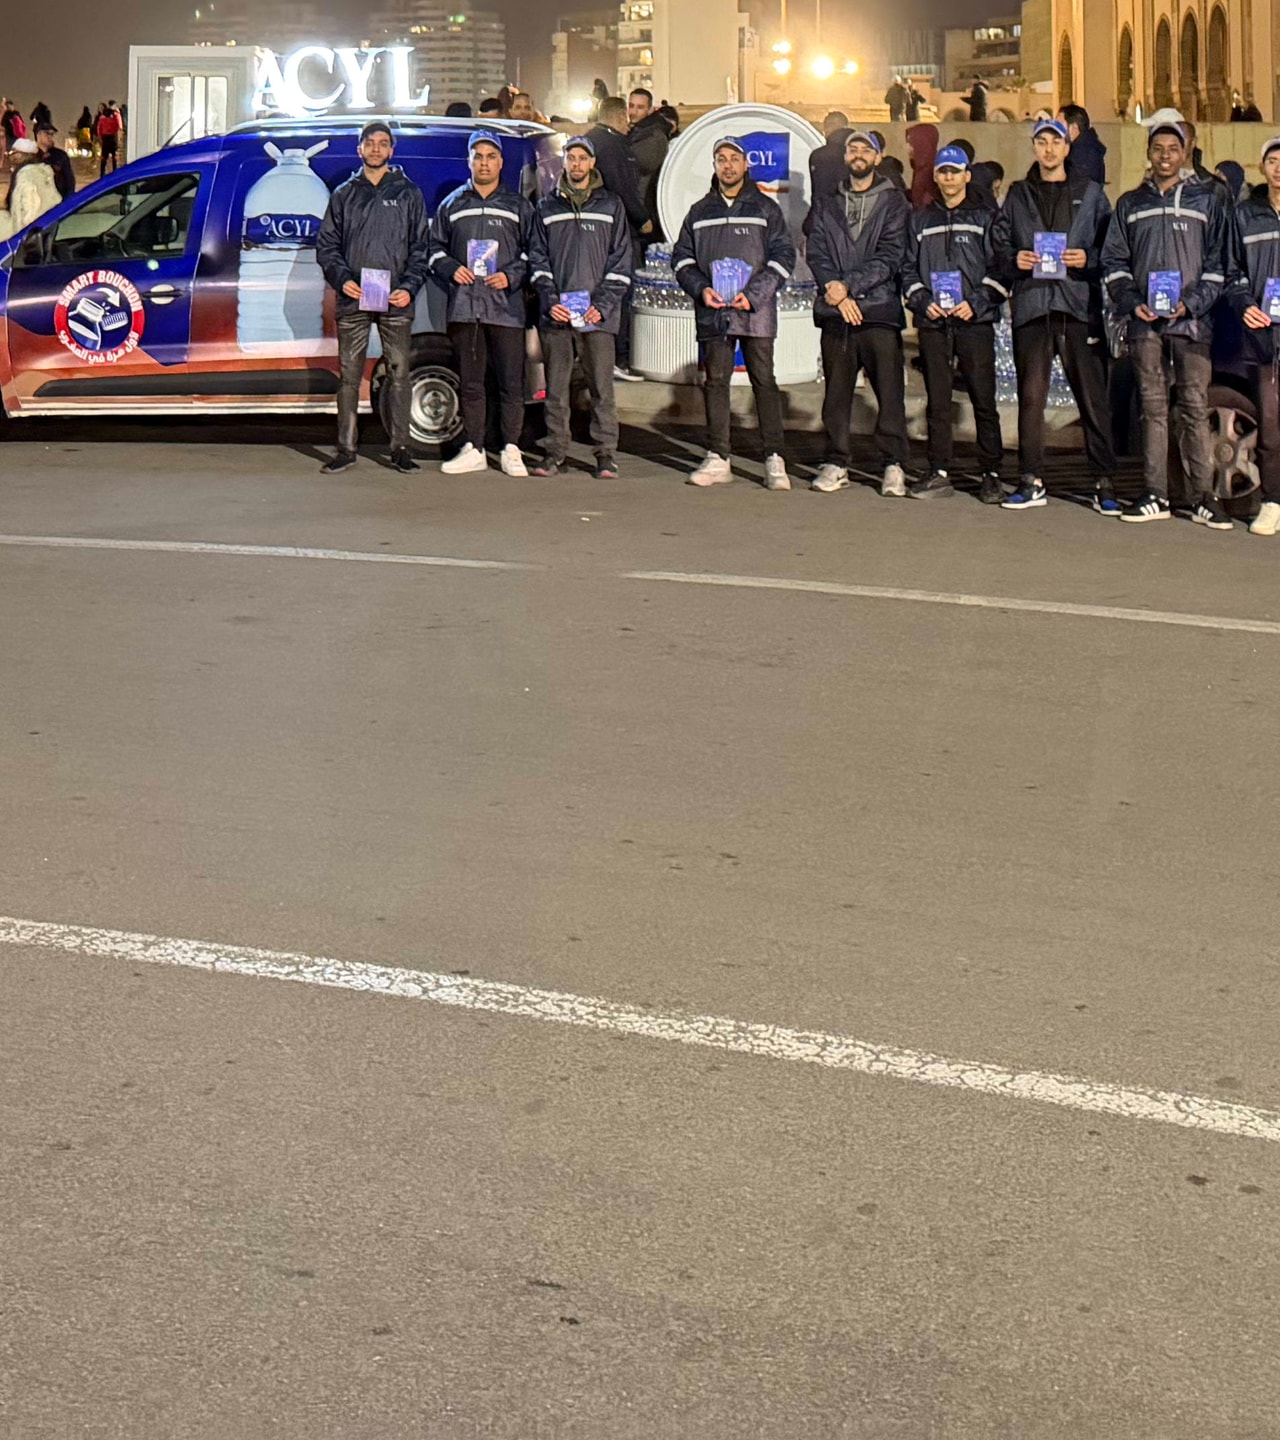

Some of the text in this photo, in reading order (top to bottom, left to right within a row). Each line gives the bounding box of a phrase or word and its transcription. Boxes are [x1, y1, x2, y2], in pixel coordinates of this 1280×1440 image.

[251, 46, 431, 117] ACYL
[746, 150, 777, 166] CYL
[265, 219, 315, 240] ACYL
[58, 270, 143, 312] SMART BOUCHON
[88, 352, 105, 364] في
